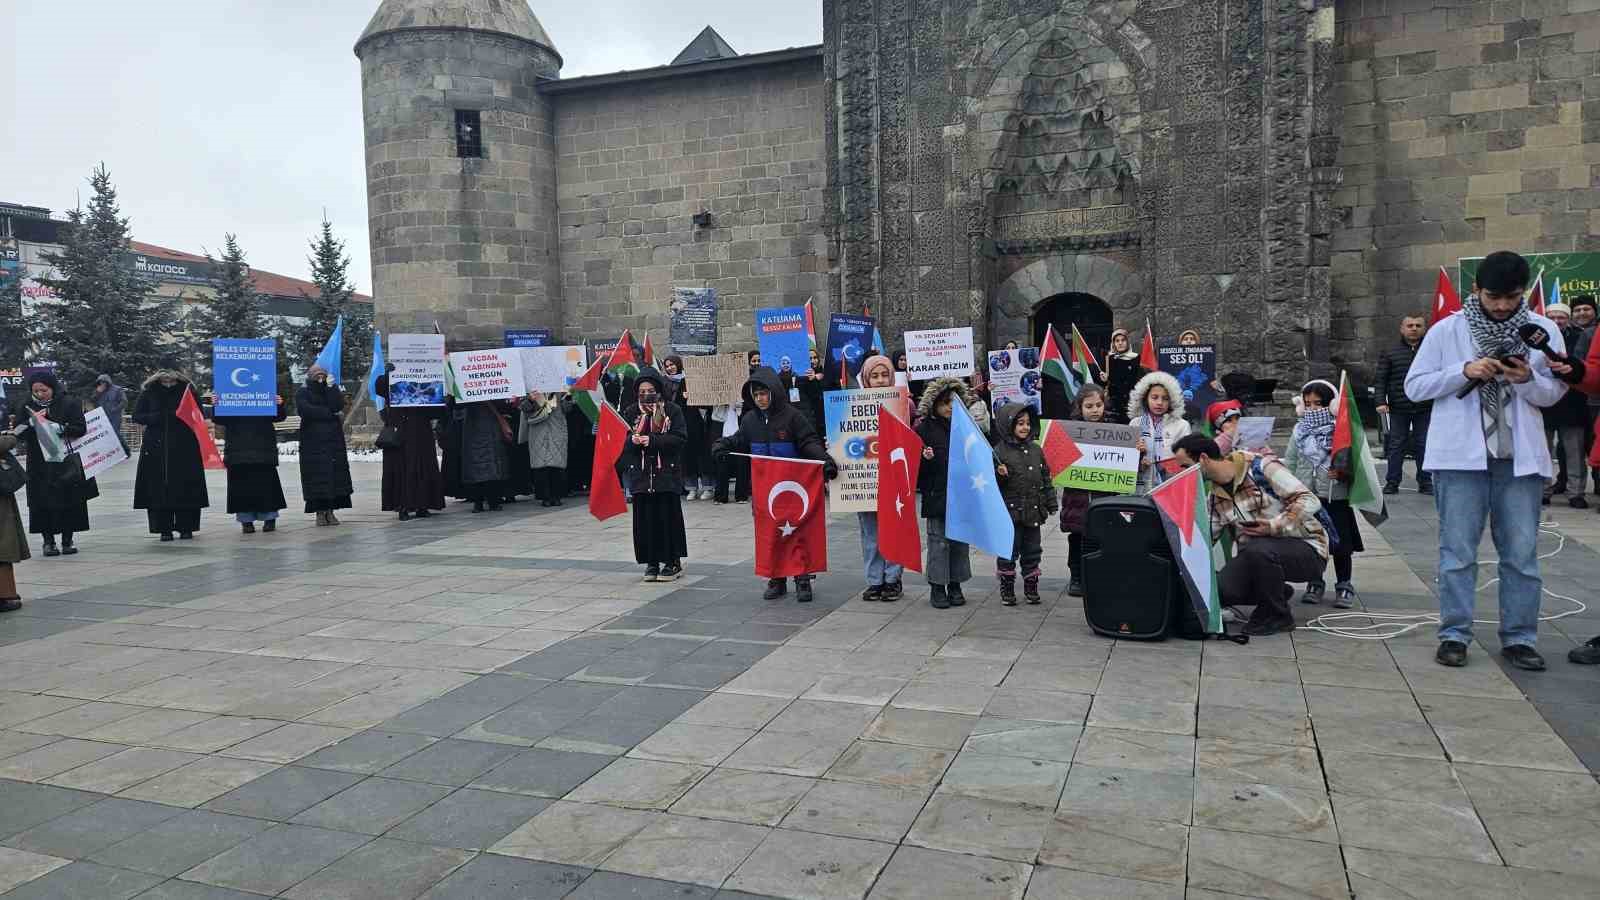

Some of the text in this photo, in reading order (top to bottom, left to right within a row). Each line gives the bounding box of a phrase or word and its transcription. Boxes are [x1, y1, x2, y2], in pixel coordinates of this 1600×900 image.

[1170, 353, 1204, 365] SES OL!
[909, 361, 969, 373] KARAR BİZİM
[840, 419, 879, 433] KARDEŞ
[1074, 427, 1132, 441] I STAND
[1093, 451, 1125, 463] WITH
[1069, 468, 1135, 486] PALESTINE
